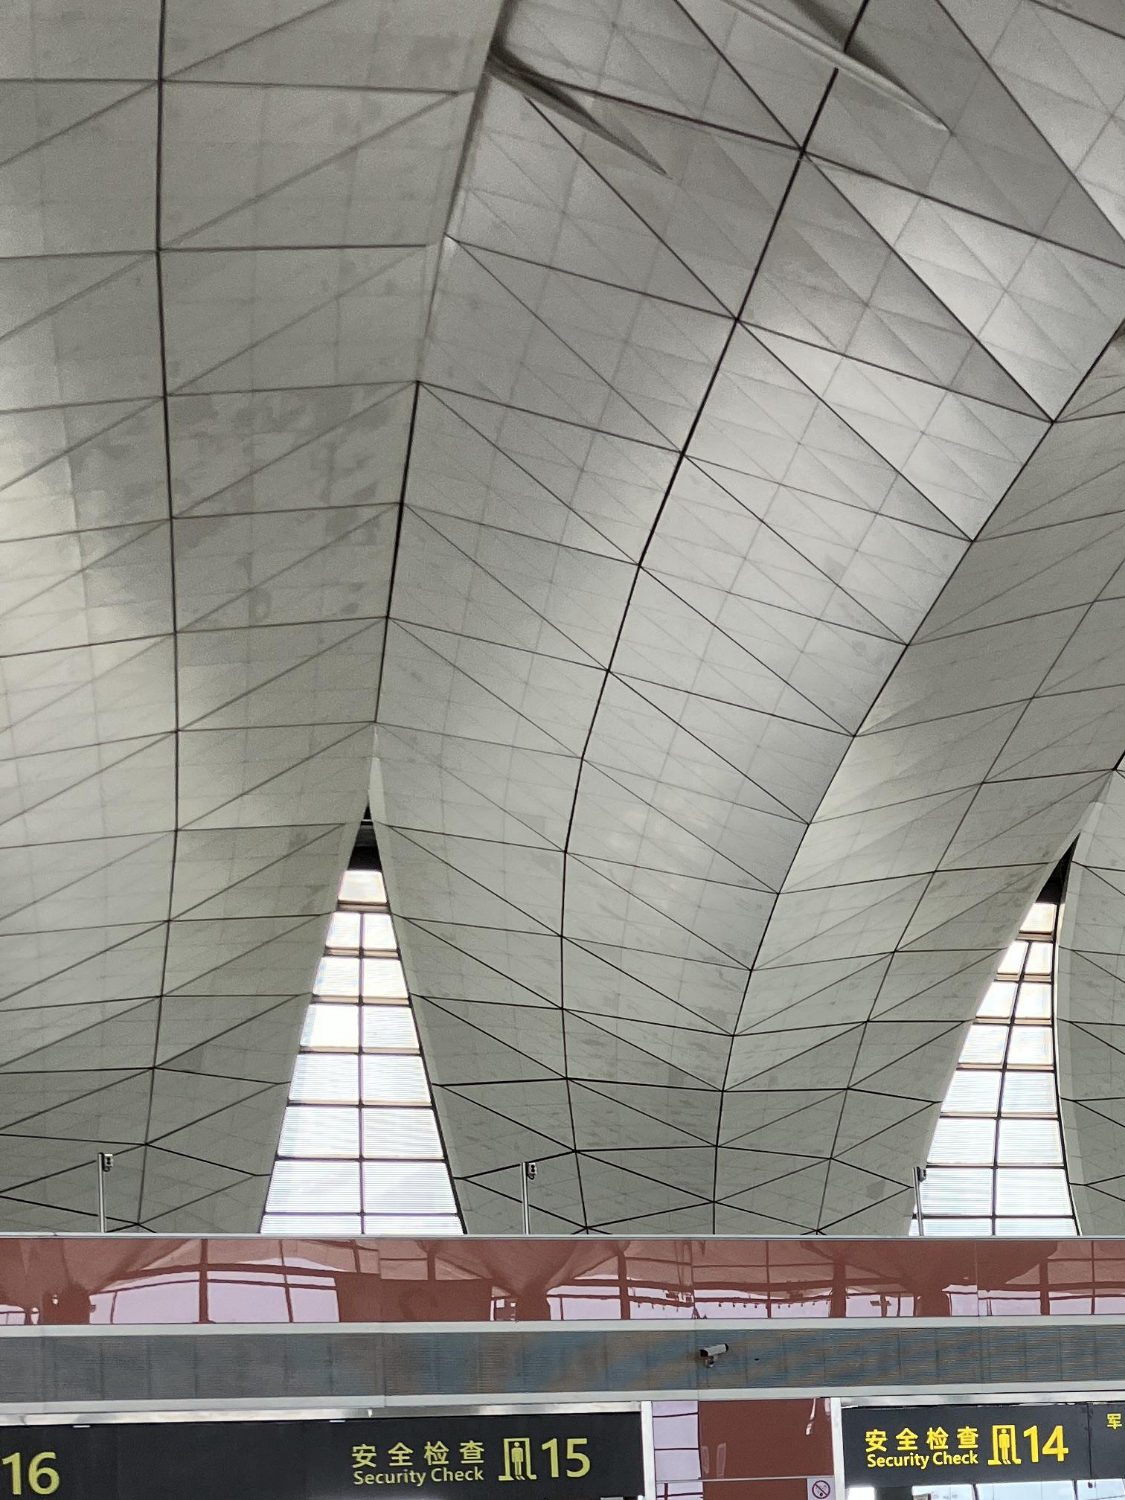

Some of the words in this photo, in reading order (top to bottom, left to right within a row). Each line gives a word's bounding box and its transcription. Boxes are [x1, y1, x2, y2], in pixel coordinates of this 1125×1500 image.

[865, 1426, 979, 1452] 安全检查
[1023, 1425, 1069, 1463] 14
[351, 1440, 485, 1468] 安全检查
[541, 1437, 591, 1478] 15
[867, 1452, 930, 1469] Security
[932, 1450, 979, 1465] Check
[2, 1451, 60, 1495] 16
[353, 1468, 426, 1487] Security
[430, 1466, 485, 1482] Check
